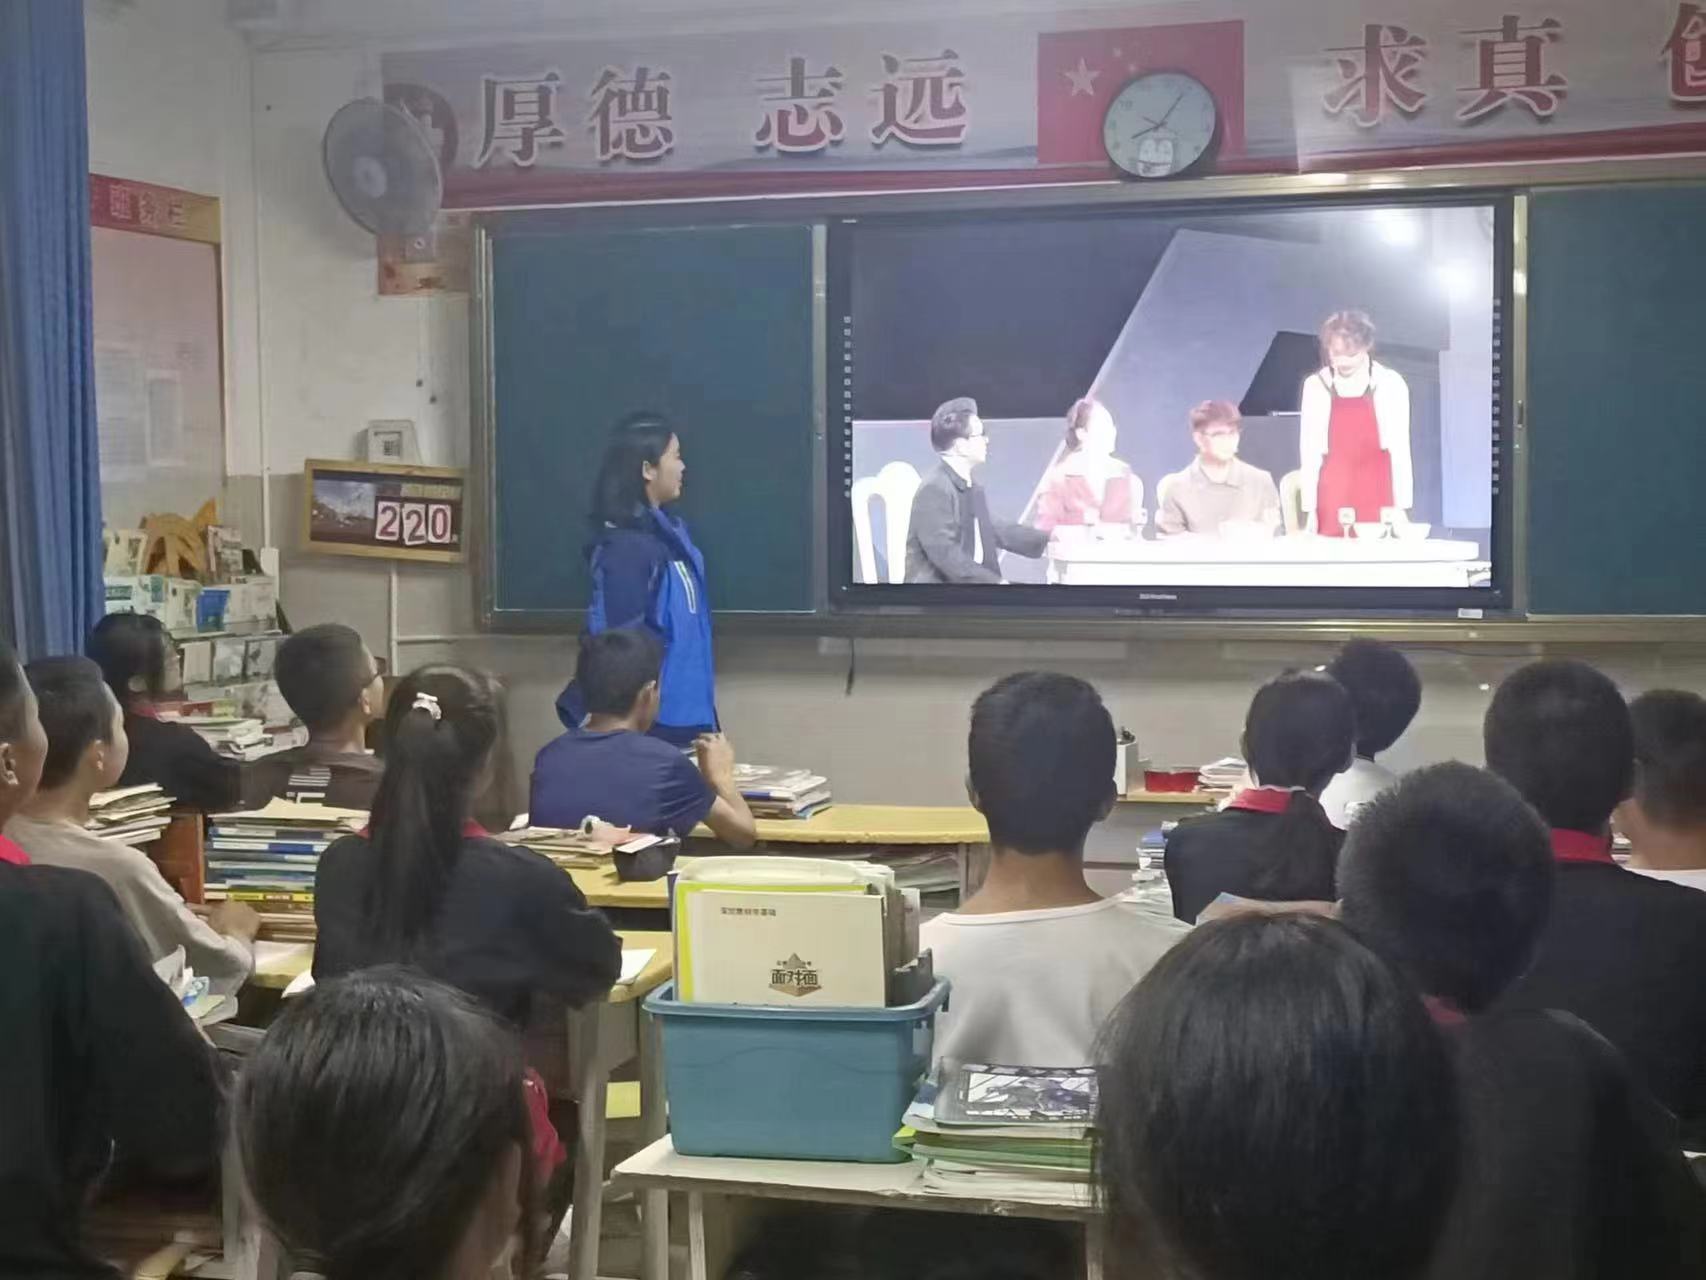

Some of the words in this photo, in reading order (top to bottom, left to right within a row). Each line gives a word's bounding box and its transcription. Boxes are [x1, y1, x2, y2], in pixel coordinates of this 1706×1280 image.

[475, 67, 675, 168] 厚德
[755, 48, 967, 152] 志远
[1322, 15, 1568, 127] 求真
[378, 505, 449, 543] 220
[771, 968, 818, 985] 面对面
